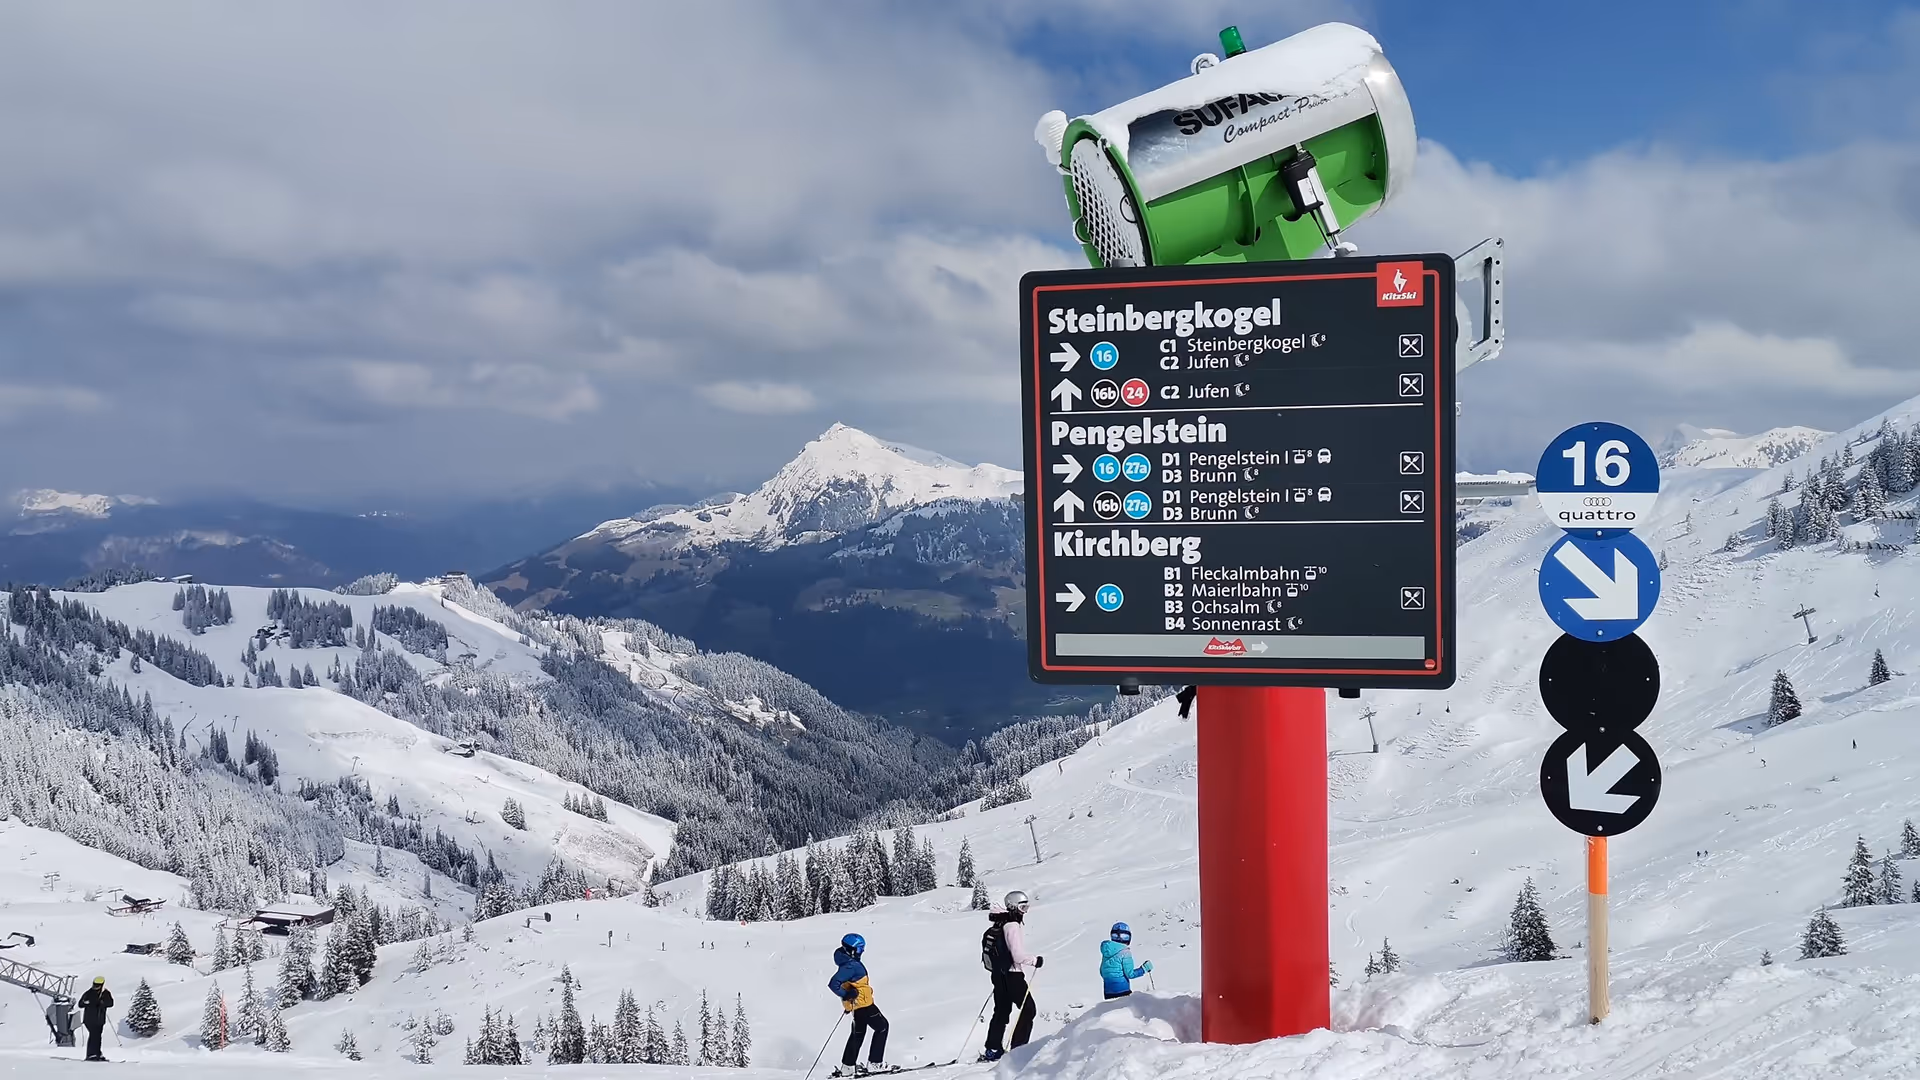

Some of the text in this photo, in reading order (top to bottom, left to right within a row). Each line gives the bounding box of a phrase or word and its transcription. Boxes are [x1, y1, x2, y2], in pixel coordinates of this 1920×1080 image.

[1382, 292, 1417, 300] KitzSki
[1049, 298, 1280, 337] Steinbergkogel
[1160, 333, 1327, 354] C1 Steinbergkogel 8
[1096, 350, 1113, 363] 16
[1160, 354, 1250, 370] C2 Jufen 8
[1093, 386, 1117, 401] 16b
[1127, 387, 1144, 399] 24
[1161, 383, 1250, 399] C2 Jufen 8
[1052, 416, 1226, 452] Pengelstein
[1162, 449, 1313, 470] D1 Pengelstein I 8
[1562, 439, 1631, 487] 16
[1098, 462, 1115, 475] 16
[1125, 461, 1148, 475] 27a
[1163, 468, 1259, 483] D3 Brunn 8
[1096, 498, 1119, 512] 16b
[1126, 498, 1149, 512] 27a
[1163, 488, 1313, 509] D1 Pengelstein I 8
[1163, 505, 1260, 520] D3 Brunn 8
[1558, 507, 1636, 523] quattro
[1055, 530, 1201, 564] Kirchberg
[1164, 566, 1328, 580] B1 Fleckalmbahn 10
[1165, 583, 1309, 597] B2 Maierlbahn 10
[1102, 592, 1118, 604] 16
[1165, 600, 1282, 613] B3 Ochsalm 8
[1165, 617, 1185, 630] B4
[1193, 617, 1281, 630] Sonnenrast
